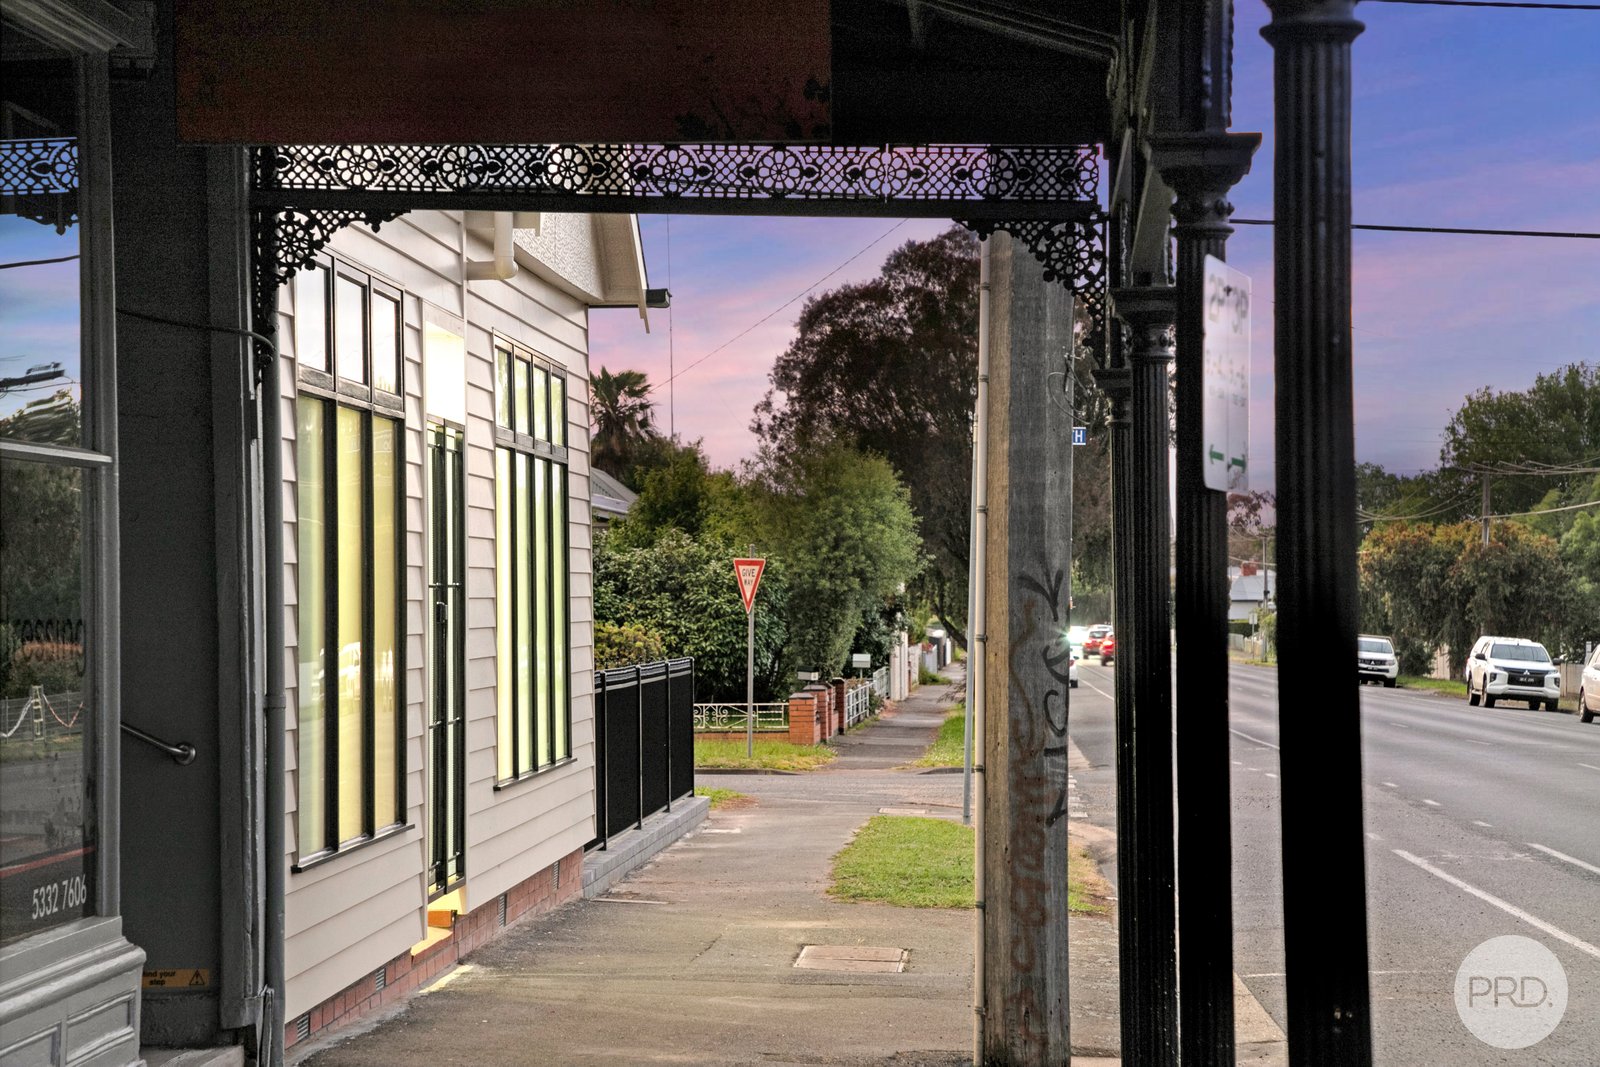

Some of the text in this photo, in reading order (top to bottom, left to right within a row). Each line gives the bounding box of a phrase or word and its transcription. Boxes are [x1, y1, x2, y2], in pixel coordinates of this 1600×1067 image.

[1074, 430, 1083, 443] H
[742, 568, 755, 577] GIVE
[32, 874, 87, 920] 5332 7606
[159, 971, 177, 979] your
